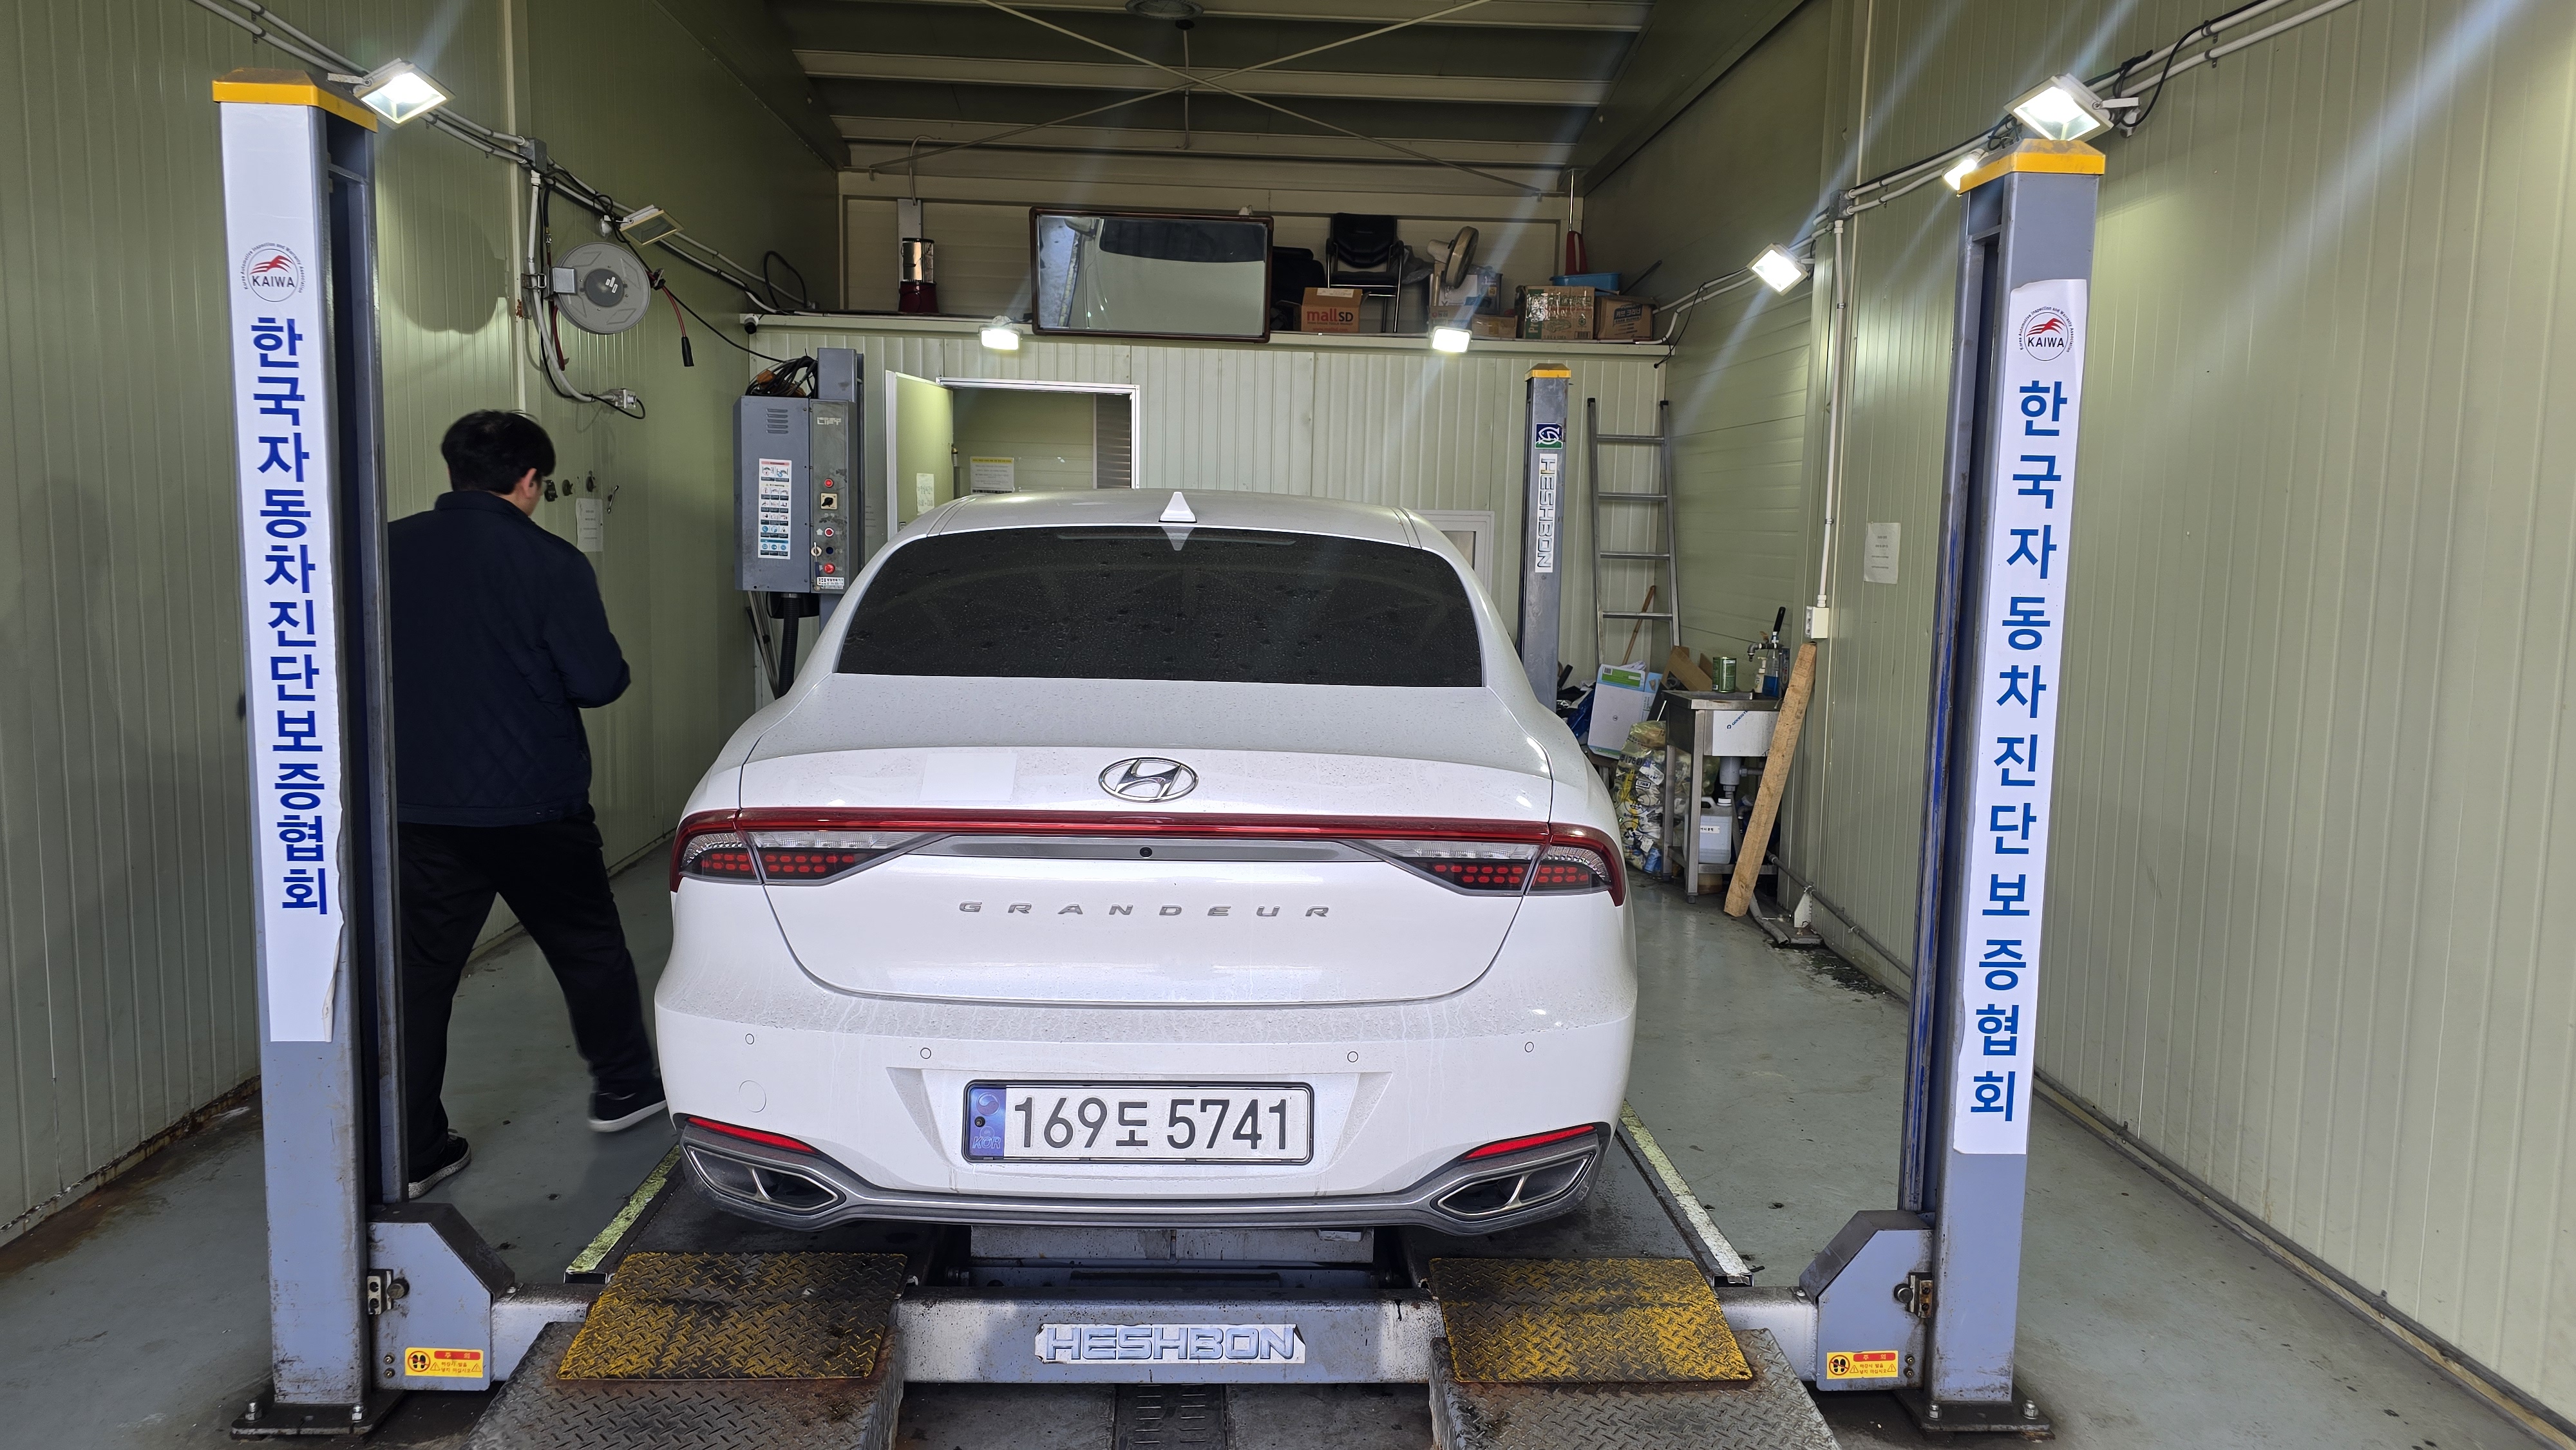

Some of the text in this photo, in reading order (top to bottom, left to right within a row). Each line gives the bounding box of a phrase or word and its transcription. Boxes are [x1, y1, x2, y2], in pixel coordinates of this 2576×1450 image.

[252, 275, 296, 288] KAIWA
[1307, 308, 1354, 322] mallSD
[2027, 337, 2065, 348] KAIWA
[1537, 458, 1555, 568] HESHBON
[250, 316, 328, 915] 한국자동차진단보증협회
[1971, 380, 2068, 1122] 한국자동차진단보증협회
[959, 901, 1330, 918] GRANDEUR
[1014, 1097, 1287, 1150] 169도 5741
[972, 1136, 1001, 1149] KOR
[1045, 1326, 1296, 1361] HESHBON
